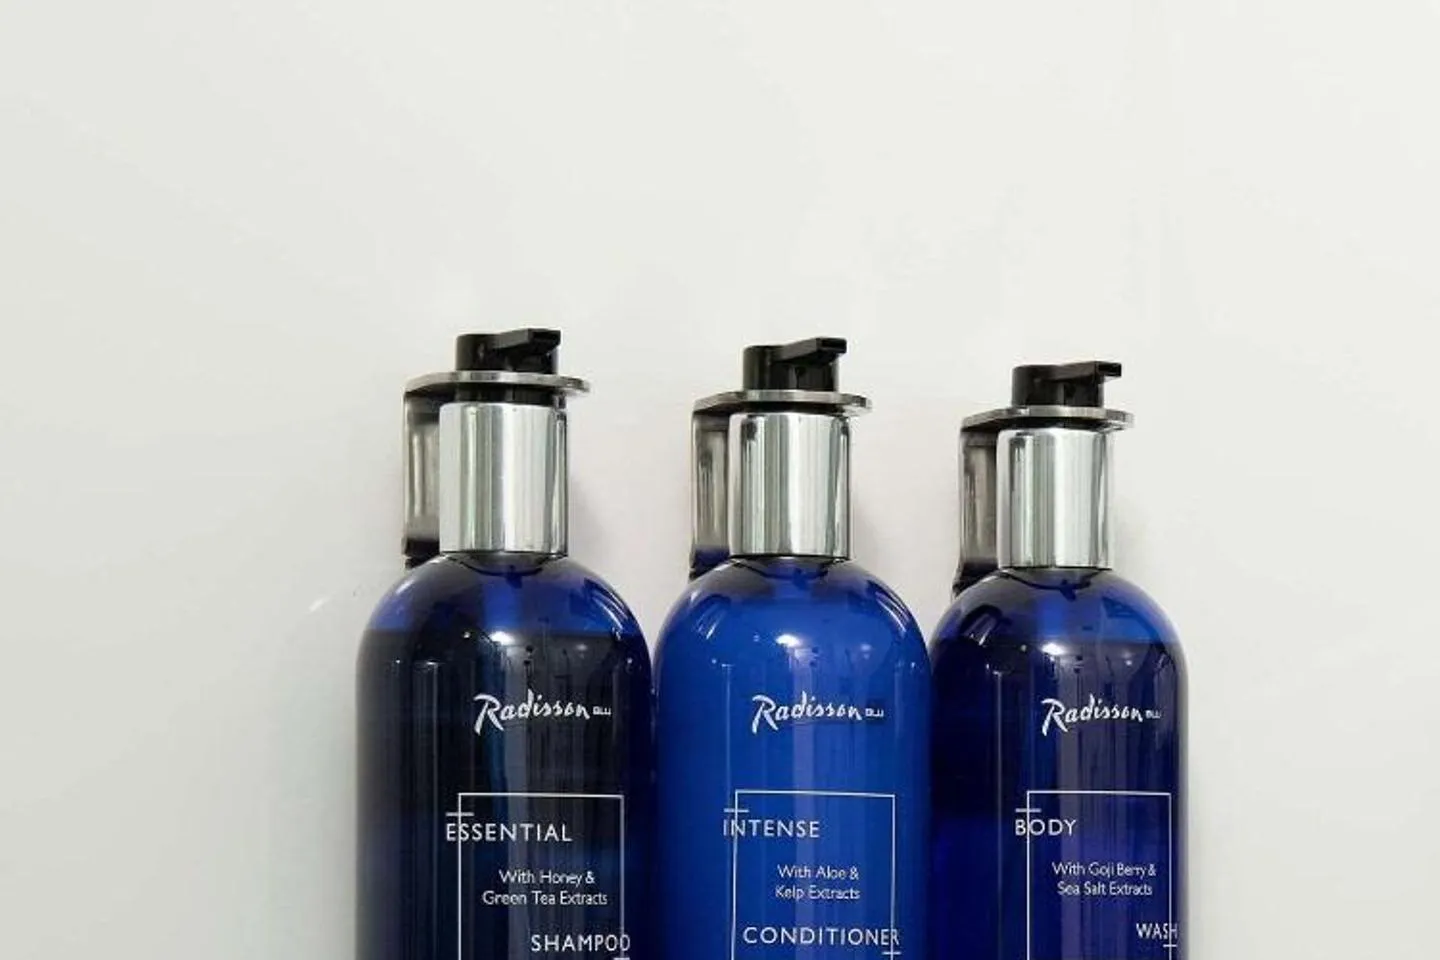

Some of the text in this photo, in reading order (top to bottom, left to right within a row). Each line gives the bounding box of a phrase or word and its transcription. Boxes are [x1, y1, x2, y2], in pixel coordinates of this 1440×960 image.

[474, 688, 590, 736] Radisson
[752, 690, 863, 735] Radisson
[1041, 693, 1143, 737] Radisson
[445, 823, 573, 842] ESSENTIAL
[723, 819, 820, 839] INTENSE
[1014, 819, 1077, 836] BODY
[498, 869, 595, 888] With Honey &
[777, 864, 859, 880] With Aloe &
[1051, 862, 1156, 880] With Goji Berry &
[482, 890, 608, 905] Green Tea Extracts
[775, 884, 861, 901] Kelp Extracts
[1057, 881, 1153, 896] Sea Salt Extracts
[743, 926, 900, 946] CONDITIONER
[1135, 922, 1178, 940] WASH
[531, 934, 631, 952] SHAMPOO
